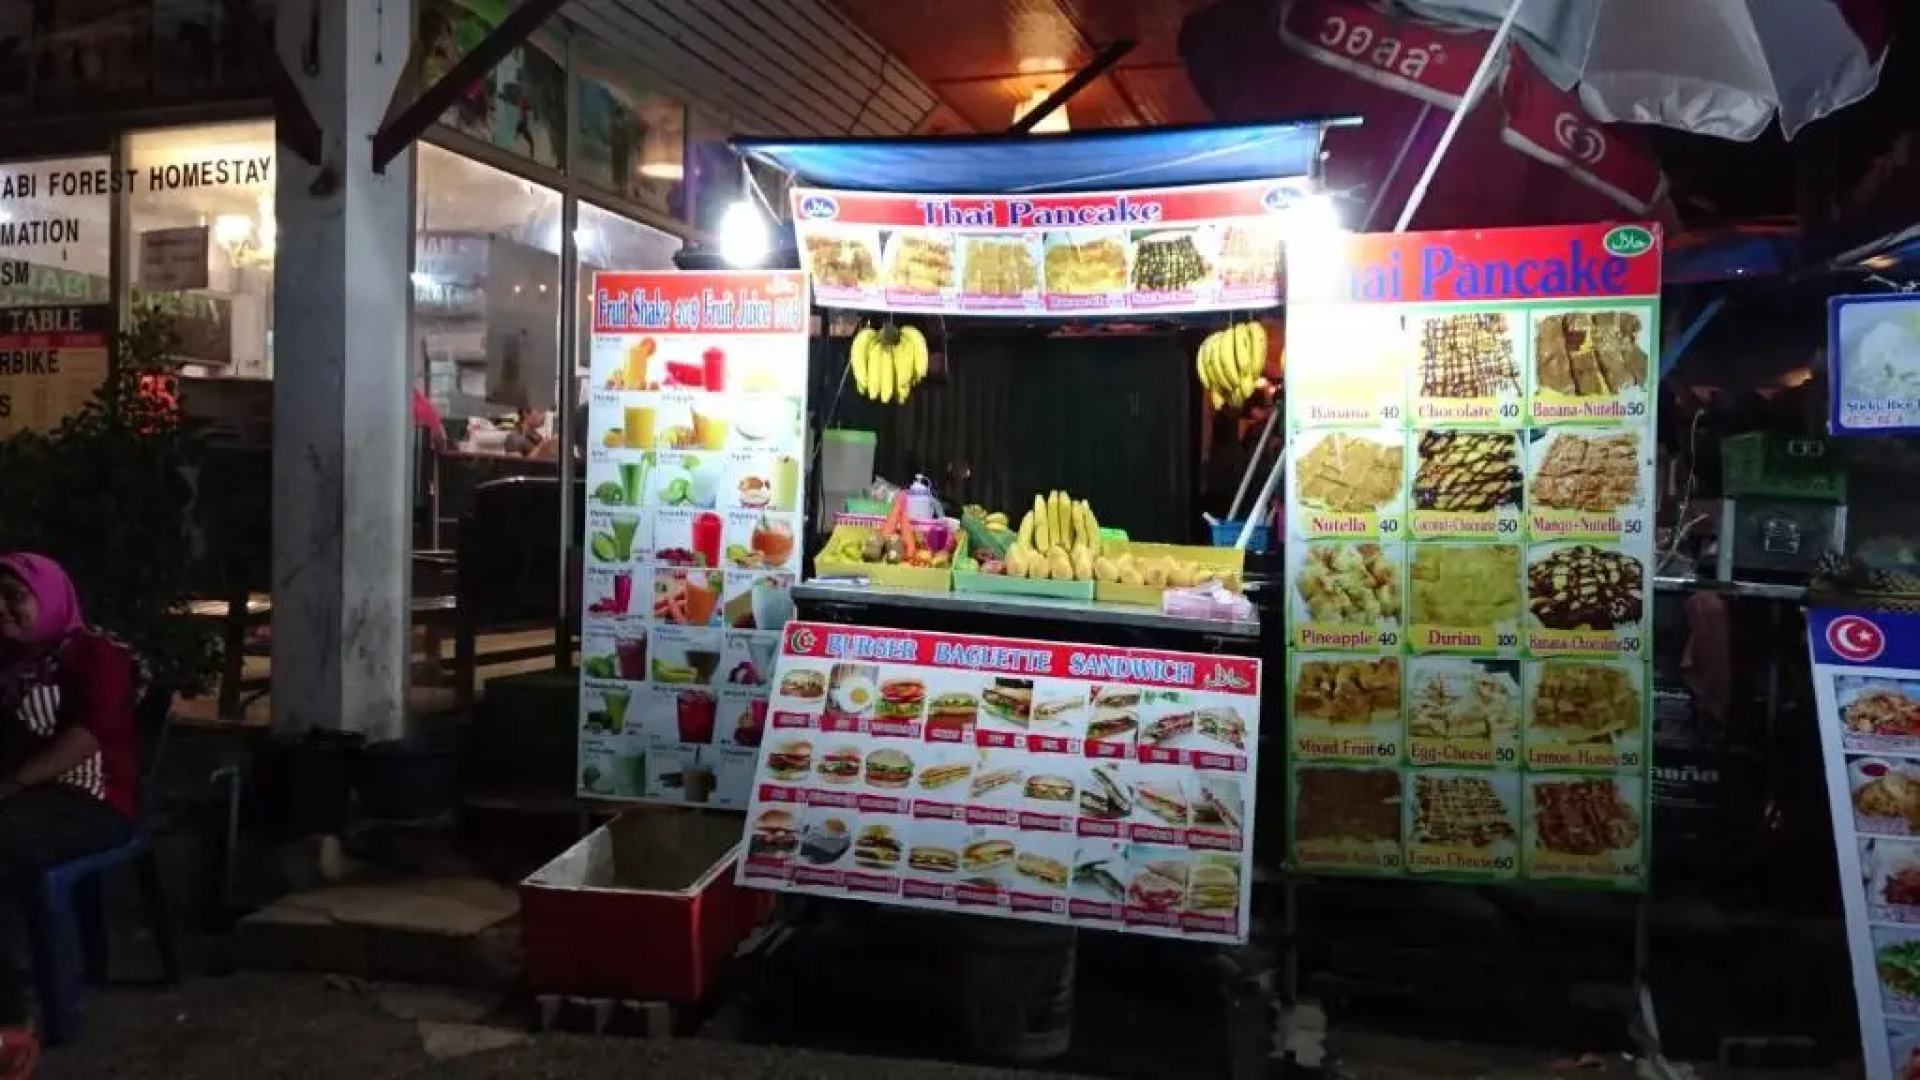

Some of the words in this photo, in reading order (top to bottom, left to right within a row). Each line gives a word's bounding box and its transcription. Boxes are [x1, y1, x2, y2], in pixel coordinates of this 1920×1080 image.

[49, 169, 138, 196] FOREST
[150, 157, 271, 191] HOMESTAY
[916, 199, 995, 226] Thai
[1007, 196, 1162, 226] Pancake
[1, 219, 79, 245] MATION
[2, 261, 29, 286] SM
[1421, 240, 1630, 298] Pancake
[599, 287, 629, 327] Fruit
[631, 286, 671, 327] Shake
[703, 288, 735, 327] Fruit
[8, 308, 84, 331] TABLE
[1311, 404, 1370, 419] Banana
[1379, 405, 1399, 419] 40
[1418, 402, 1494, 419] Chocolate
[1500, 403, 1519, 417] 40
[1533, 402, 1626, 417] Banana-Nutella
[1627, 402, 1645, 415] 50
[1312, 516, 1366, 532] Nutella
[1379, 518, 1398, 532] 40
[1497, 518, 1518, 533] 50
[1625, 519, 1642, 533] 50
[1302, 629, 1374, 648] Pineapple
[1378, 632, 1398, 646] 40
[1427, 629, 1482, 646] Durian
[1497, 634, 1518, 646] 100
[1622, 637, 1640, 651] 50
[826, 633, 917, 661] BURGER
[1068, 652, 1195, 685] SANDWICH
[1299, 738, 1337, 754] Mixed
[1344, 741, 1375, 755] Fruit
[1378, 743, 1396, 756] 60
[1411, 742, 1491, 762] Egg-Cheese
[1621, 752, 1638, 766] 50
